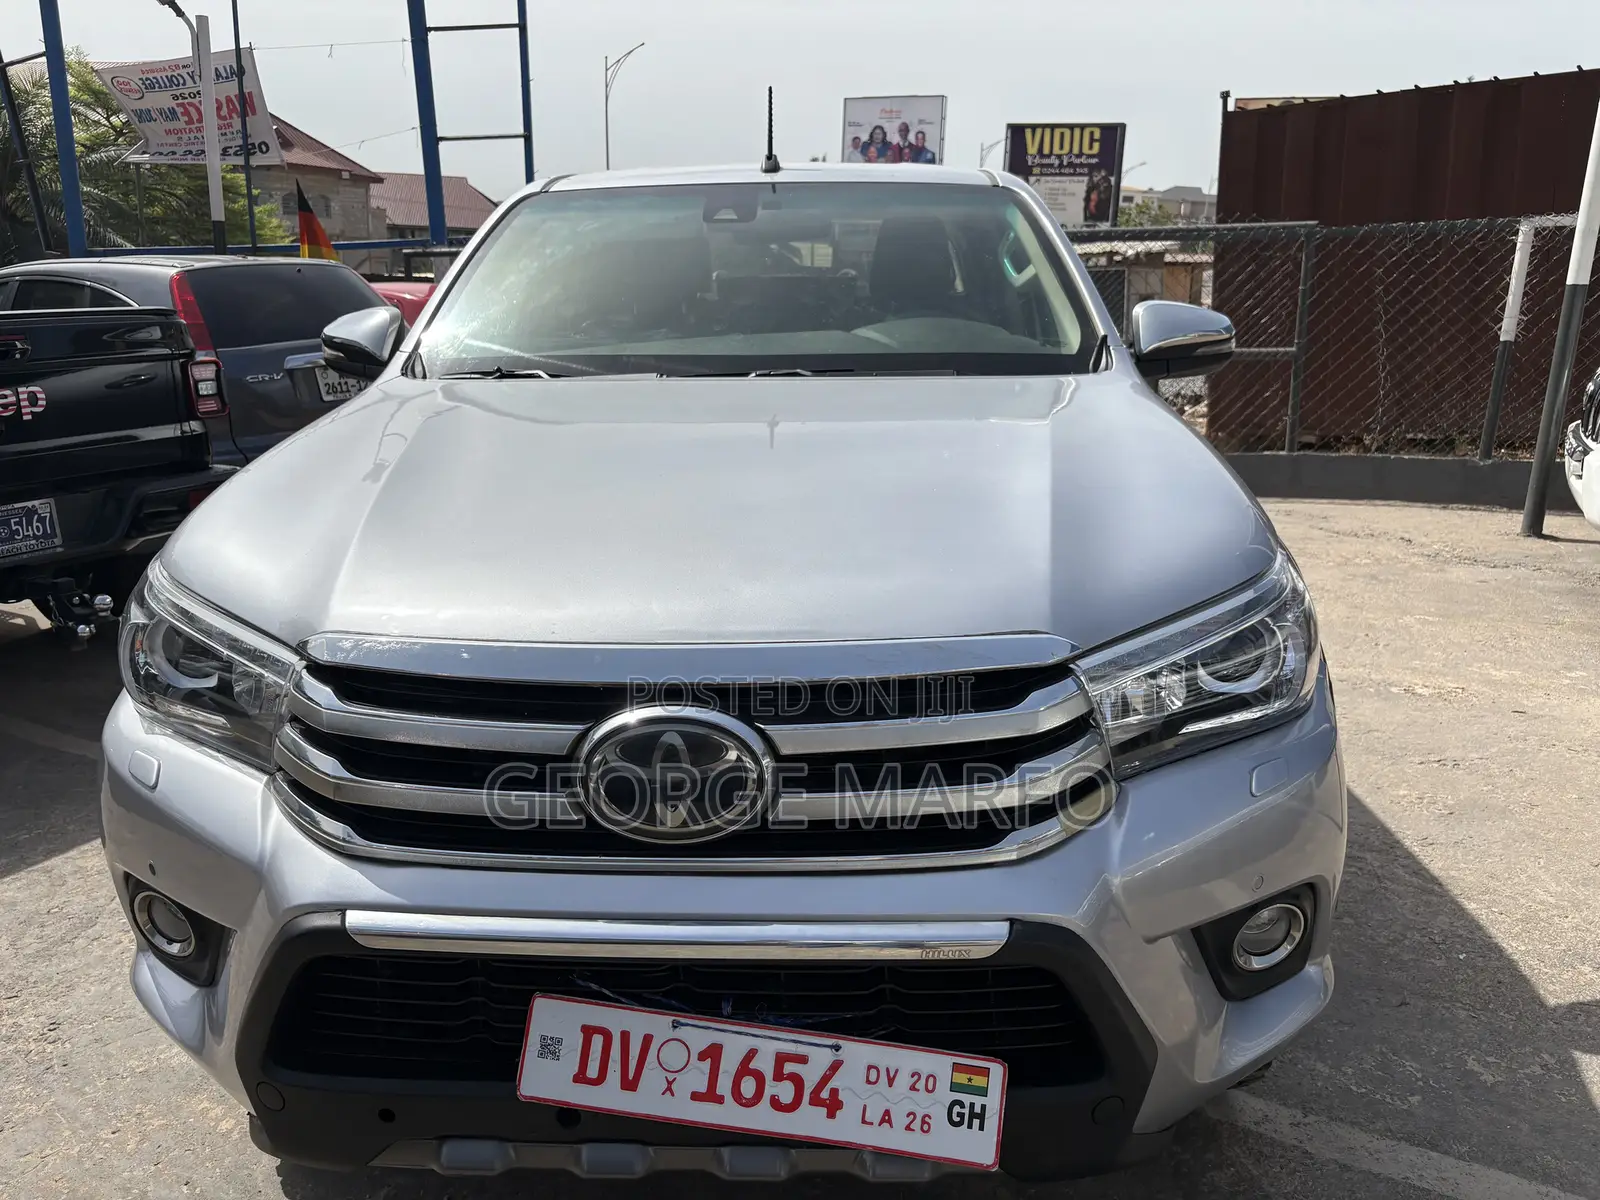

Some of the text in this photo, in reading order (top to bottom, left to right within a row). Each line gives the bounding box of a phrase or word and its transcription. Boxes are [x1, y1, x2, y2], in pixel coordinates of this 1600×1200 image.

[1024, 127, 1101, 155] VIDIC
[1026, 154, 1100, 167] Beauty Parlour
[246, 372, 284, 382] CR-V
[11, 513, 51, 539] 5467
[24, 540, 56, 551] TOYOTA
[920, 949, 972, 958] HILUX
[572, 1023, 654, 1093] DV
[689, 1041, 845, 1120] 1654
[865, 1064, 938, 1094] DV 20
[861, 1104, 932, 1134] LA 26
[946, 1099, 987, 1132] GH
